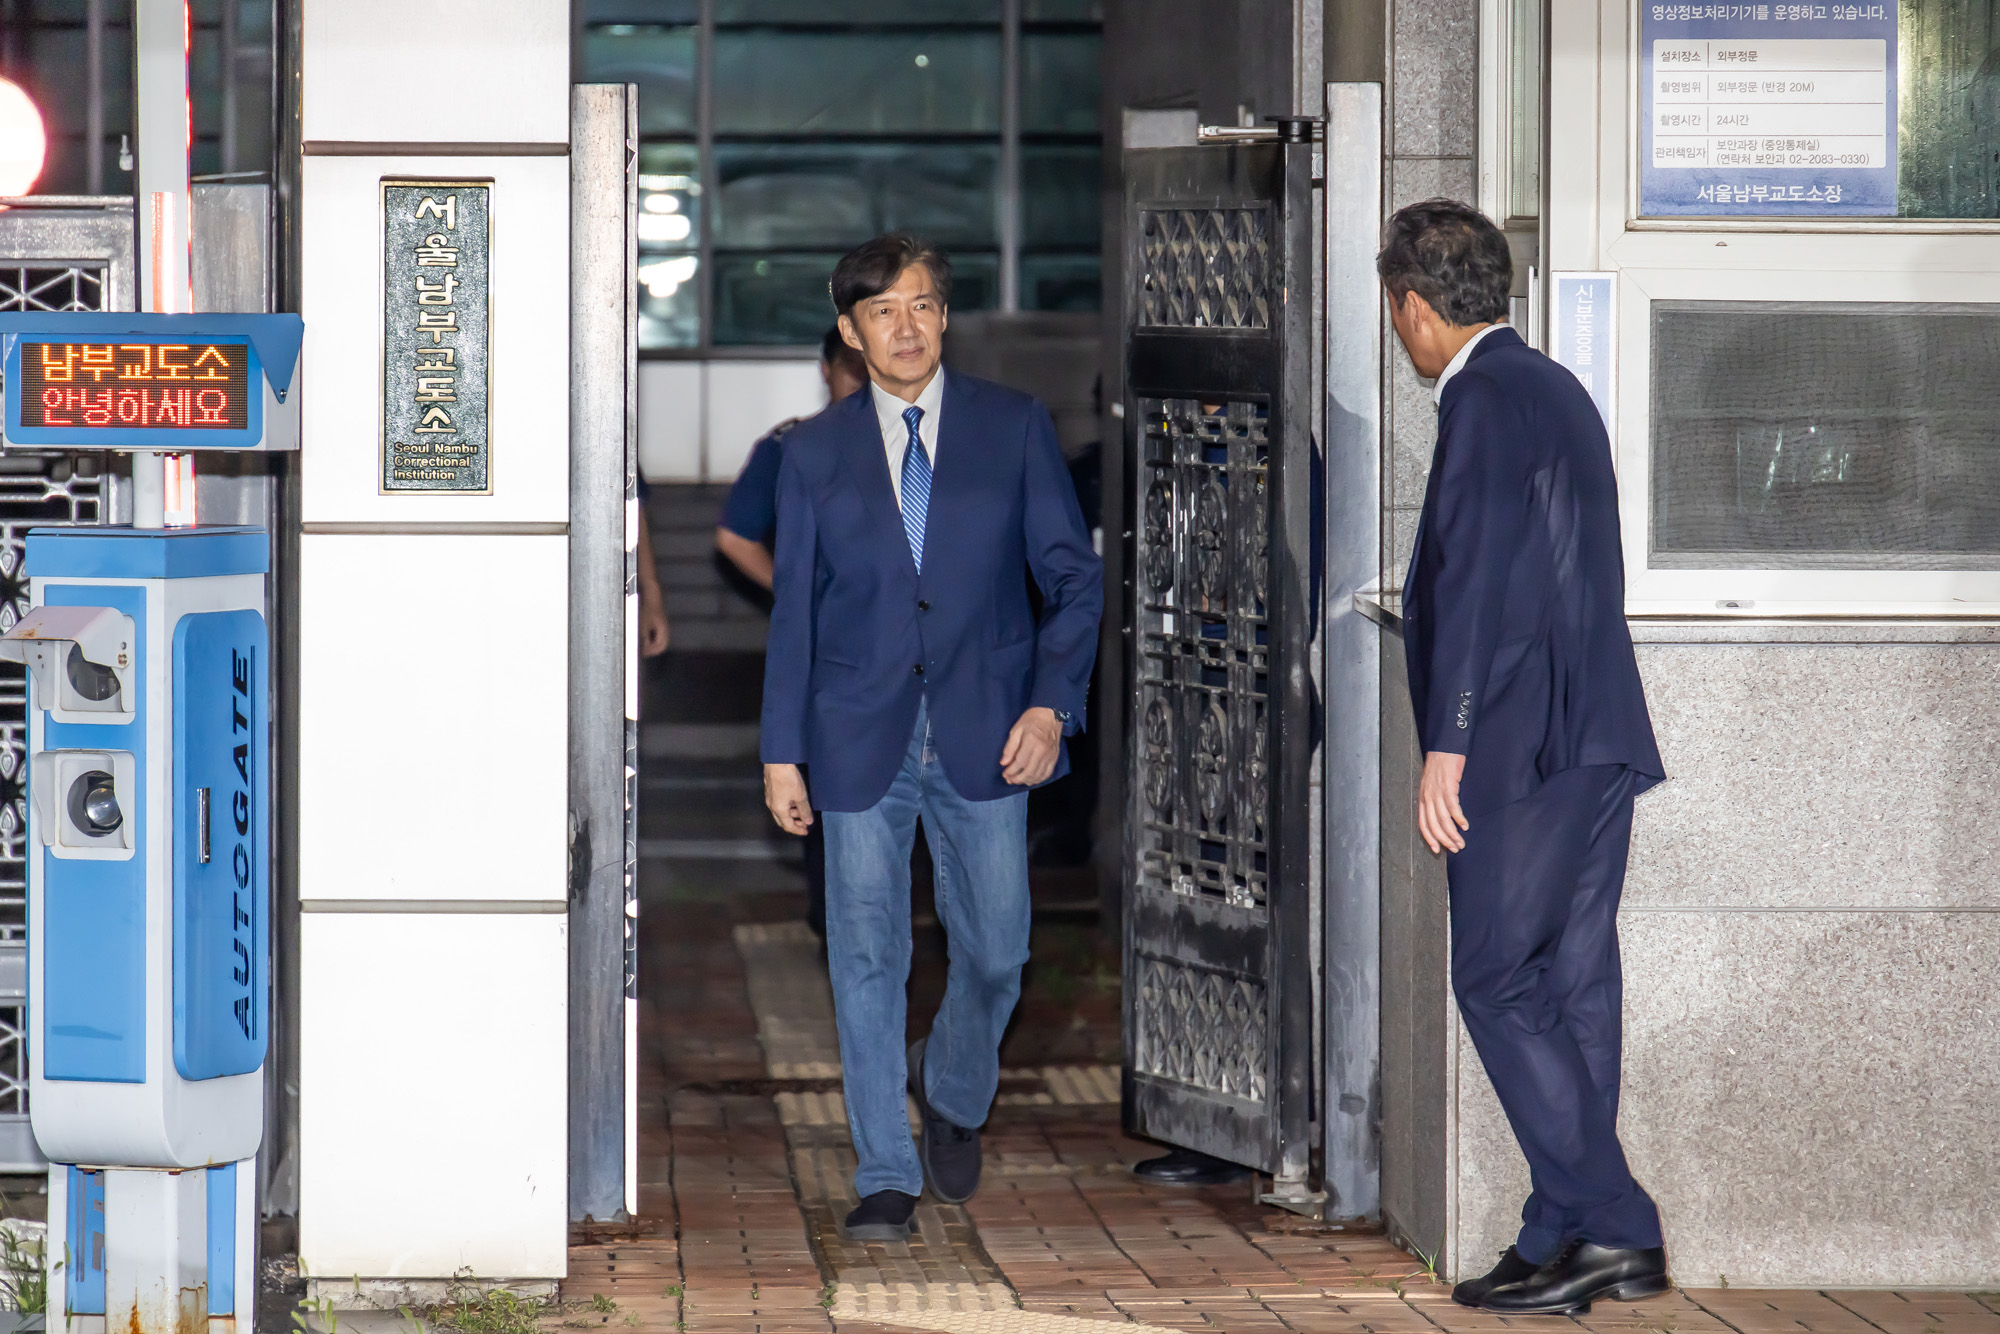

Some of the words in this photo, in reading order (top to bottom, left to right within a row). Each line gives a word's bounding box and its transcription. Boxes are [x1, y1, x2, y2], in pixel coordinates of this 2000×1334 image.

[1652, 4, 1769, 21] 영상정보처리기기를
[1774, 4, 1827, 21] 운영하고
[1832, 4, 1888, 21] 있습니다.
[1661, 50, 1702, 63] 설치장소
[1717, 50, 1758, 63] 외부정문
[1661, 81, 1701, 94] 촬영범위
[1717, 81, 1758, 94] 외부정문
[1761, 81, 1786, 94] (반경
[1789, 81, 1815, 94] 20M)
[1660, 114, 1702, 127] 촬영시간
[1716, 114, 1750, 127] 24시간
[1716, 139, 1758, 152] 보안과장
[1761, 139, 1821, 152] (중앙통제실)
[1655, 147, 1707, 159] 관리책임자
[1716, 153, 1752, 166] (연락처
[1754, 153, 1786, 166] 보안과
[1789, 153, 1870, 166] 02-2083-0330)
[1696, 184, 1843, 204] 서울남부교도소장
[414, 194, 460, 434] 서울남부교도소
[1574, 284, 1595, 366] 신분증을
[41, 344, 230, 382] 남부교도소
[41, 387, 230, 426] 안녕하세요
[394, 442, 430, 453] Seoul
[434, 443, 478, 453] Nambu
[394, 456, 470, 467] Correctional
[394, 469, 455, 480] Institution
